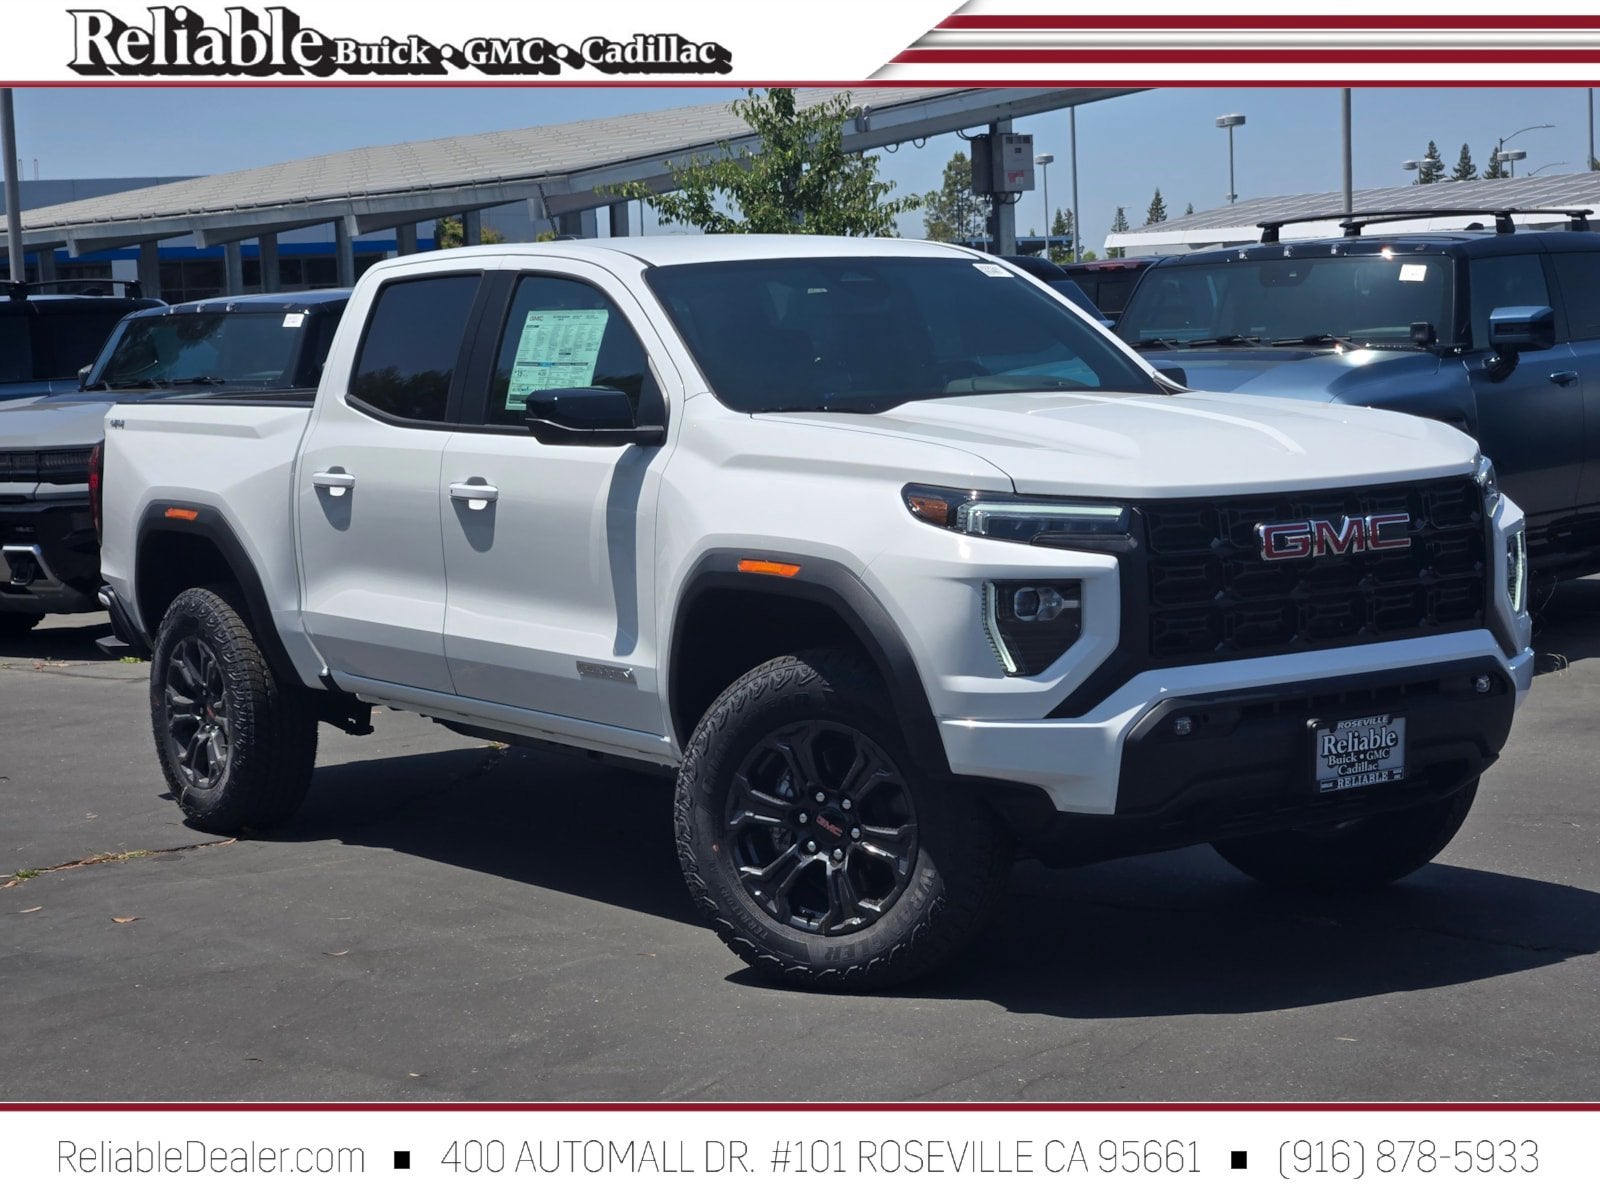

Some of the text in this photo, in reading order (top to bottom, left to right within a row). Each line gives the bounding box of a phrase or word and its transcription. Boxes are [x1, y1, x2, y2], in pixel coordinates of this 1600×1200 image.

[1257, 512, 1411, 561] GMC
[1337, 714, 1390, 730] ROSEVILLE
[1322, 726, 1398, 757] Reliable
[1328, 748, 1391, 766] Buick GMC
[1338, 760, 1379, 776] Cadillac
[1336, 771, 1389, 790] RELIABLE
[816, 815, 844, 838] GMC
